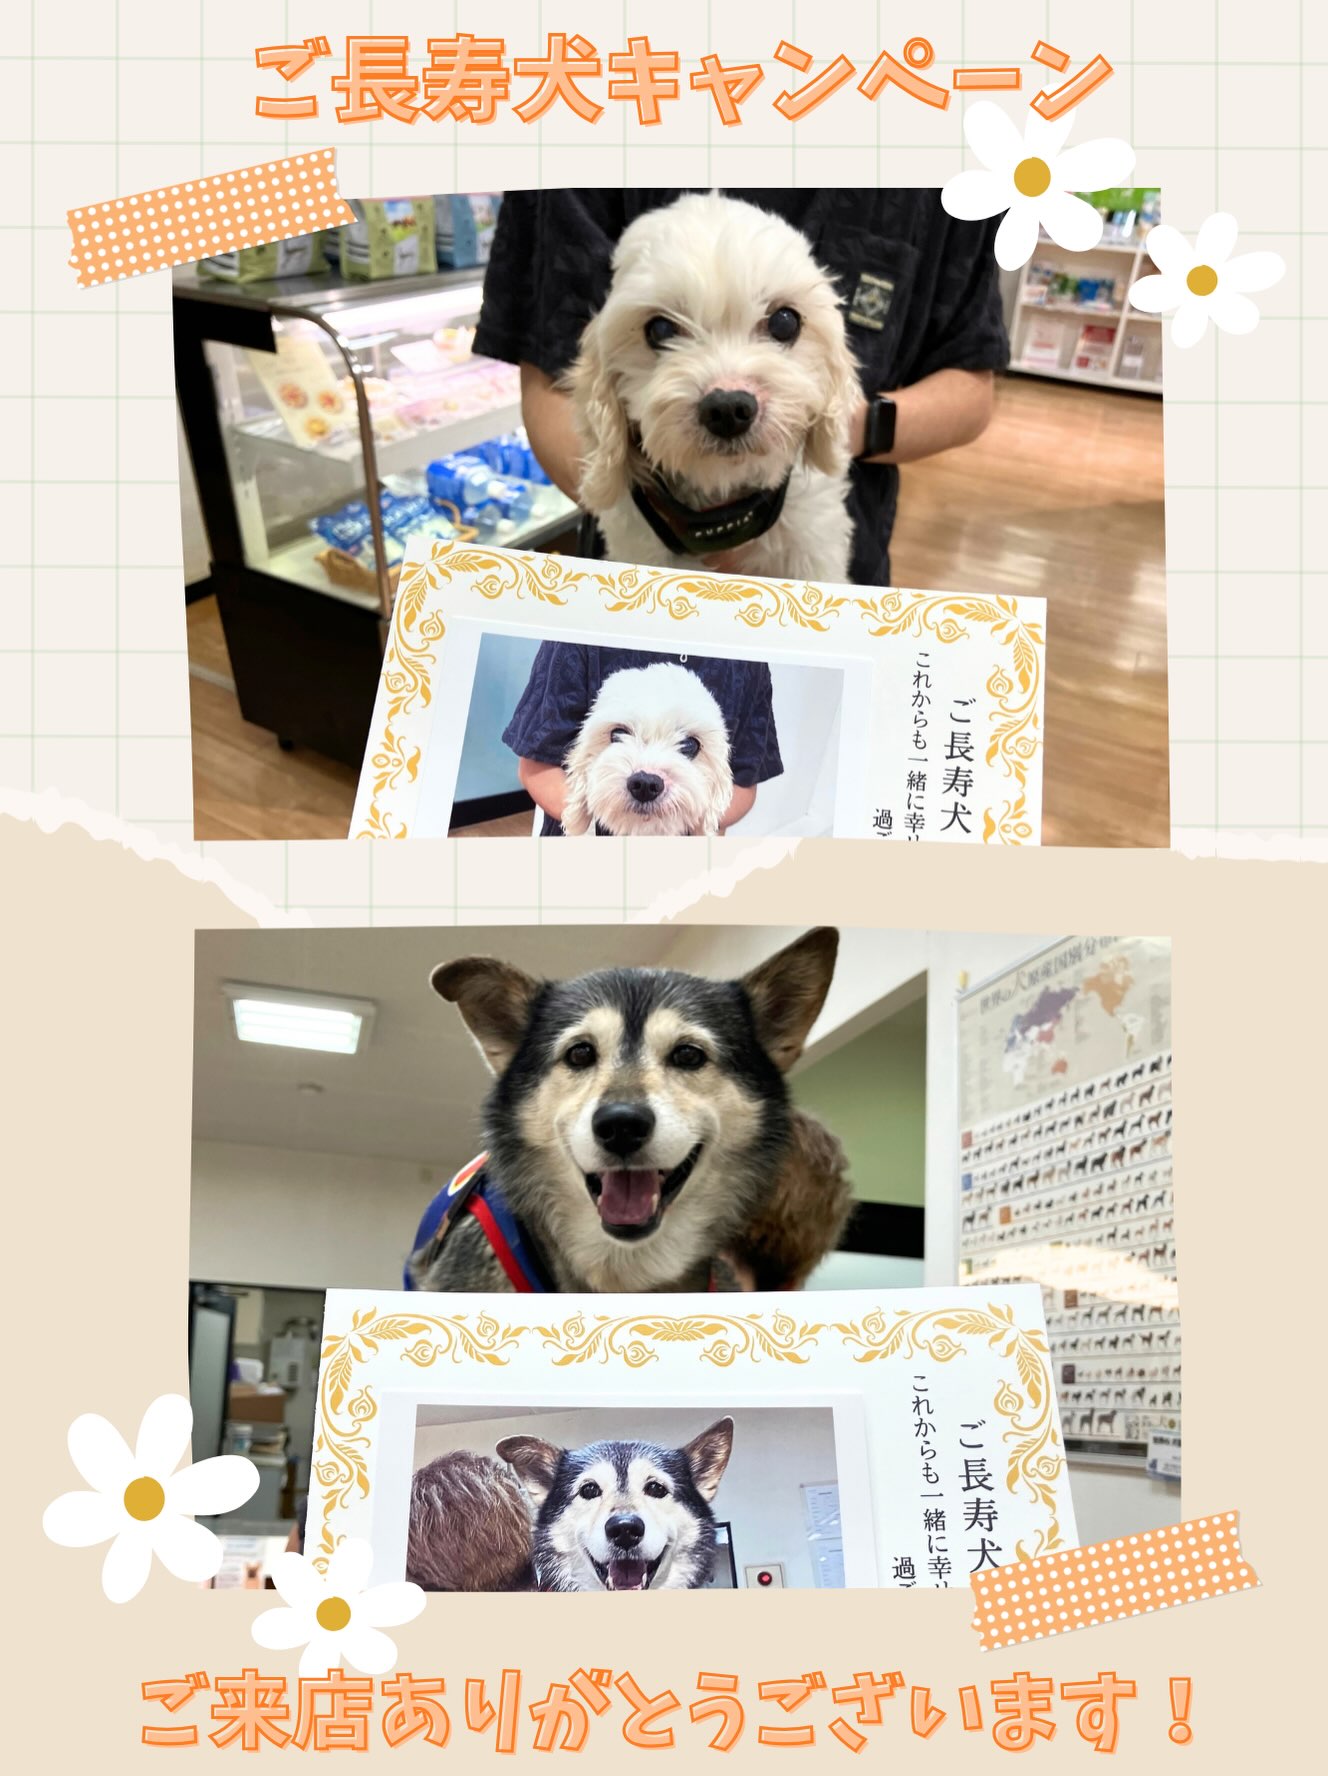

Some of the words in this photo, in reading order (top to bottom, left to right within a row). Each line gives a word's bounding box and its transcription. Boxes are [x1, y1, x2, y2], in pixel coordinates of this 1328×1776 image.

[940, 697, 976, 834] ご長寿犬
[958, 1419, 1003, 1574] ご長寿犬
